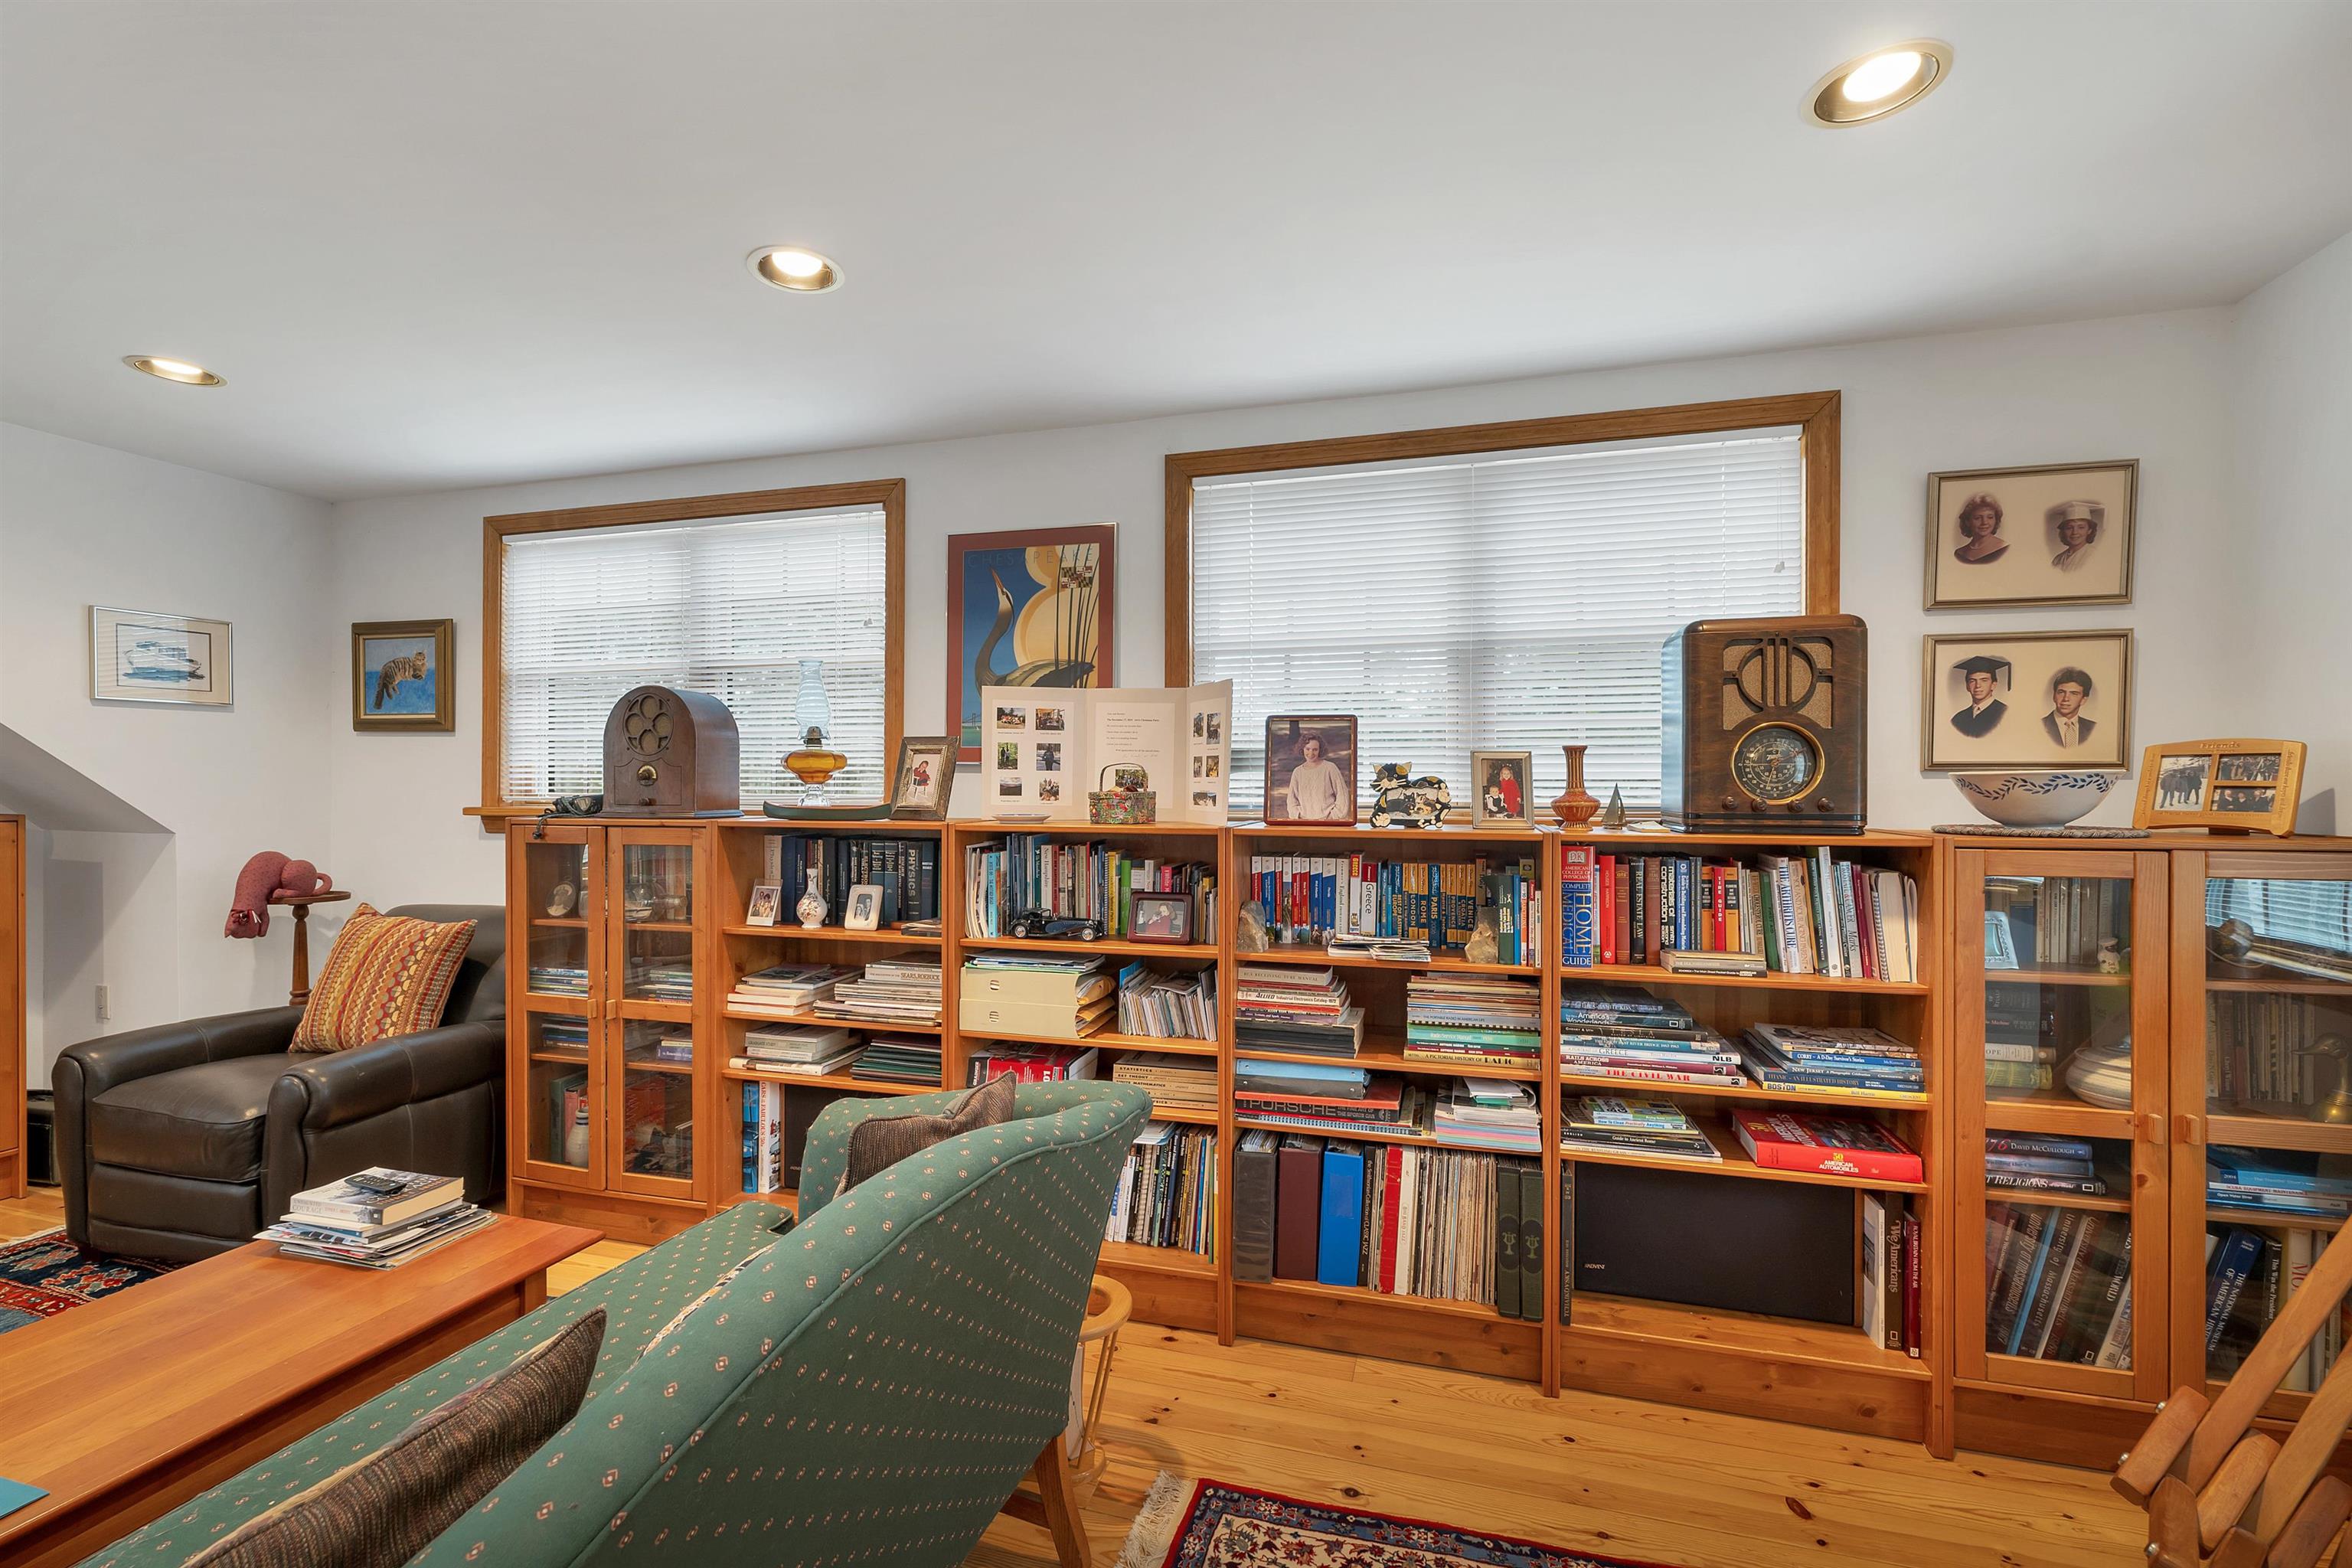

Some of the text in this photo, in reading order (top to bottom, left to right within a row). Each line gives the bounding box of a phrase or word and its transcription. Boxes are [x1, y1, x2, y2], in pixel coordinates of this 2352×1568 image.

[1570, 852, 1583, 861] DK
[1779, 865, 1789, 883] THE
[1841, 864, 1851, 893] PROSTATE
[1365, 884, 1374, 913] Greece
[1780, 884, 1795, 926] ARTHRITIS
[1844, 899, 1854, 923] CANCER
[1563, 893, 1573, 954] MEDICAL
[1576, 893, 1592, 953] HOME
[1669, 908, 1675, 916] of
[1785, 927, 1796, 949] CURE
[1848, 930, 1858, 952] Marks
[1562, 957, 1591, 965] GUIDE
[1632, 1070, 1662, 1079] CIVIL
[1667, 1073, 1690, 1082] WAR
[1250, 1100, 1336, 1116] PORSCHE
[2031, 1145, 2075, 1155] McCULLOUGH
[1819, 1165, 1859, 1173] AUTOMOBILES
[1994, 1175, 2049, 1187] RELIGIONS
[2020, 1214, 2043, 1252] University
[2077, 1217, 2099, 1260] University
[1886, 1221, 1901, 1292] We Americans
[2033, 1214, 2075, 1327] University of Massachusetts
[2271, 1272, 2279, 1283] Was
[2005, 1262, 2029, 1315] Massachusetts
[2106, 1274, 2124, 1302] WORLD
[2210, 1268, 2236, 1318] OF AMERICAN
[2208, 1272, 2246, 1351] THE NATIONAL MUSEUM
